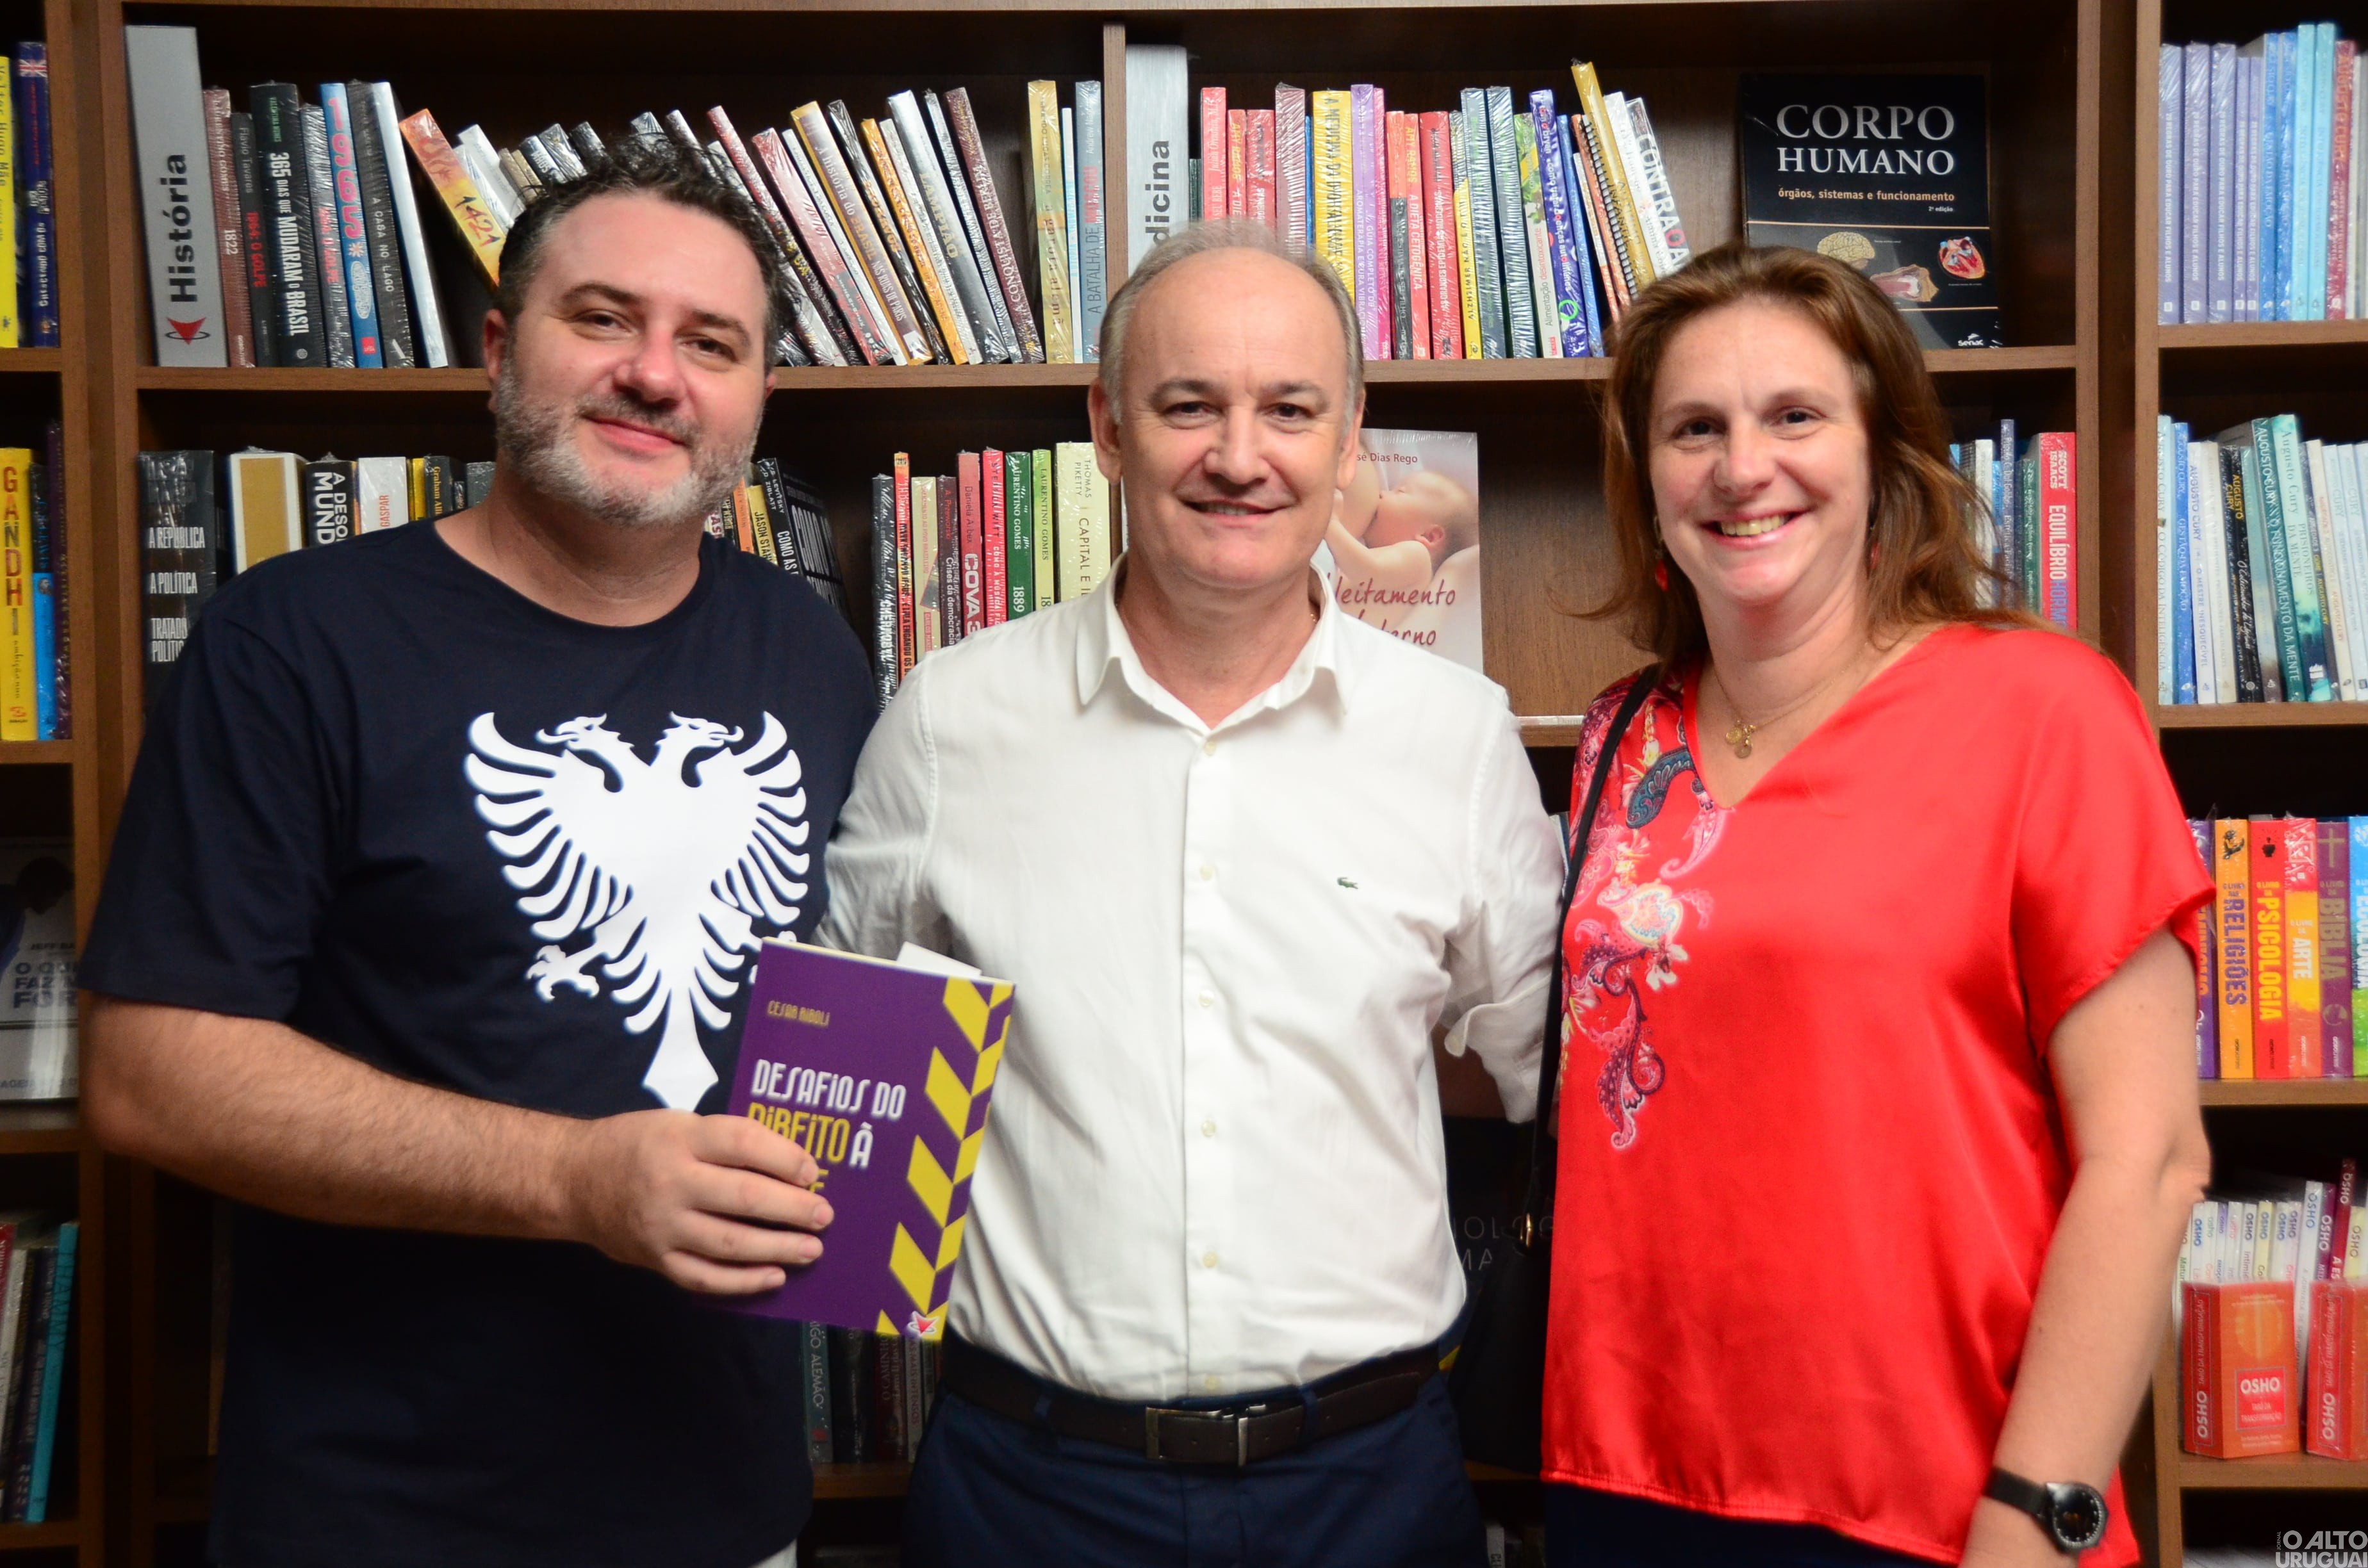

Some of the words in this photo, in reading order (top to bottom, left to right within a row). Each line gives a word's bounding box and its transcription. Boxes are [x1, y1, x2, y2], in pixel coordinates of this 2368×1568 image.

[1322, 108, 1342, 159] MEDICINA
[1776, 104, 1955, 140] CORPO
[269, 150, 292, 178] 365
[327, 98, 364, 238] 1965
[822, 154, 850, 200] história
[1776, 147, 1955, 176] HUMANO
[275, 178, 290, 197] DIAS
[1083, 165, 1100, 224] MOSCOU
[1145, 141, 1169, 247] dicina
[1778, 187, 1815, 200] órgãos,
[1818, 190, 1864, 200] sistemas
[1876, 190, 1955, 202] funcionamento
[279, 199, 292, 214] QUE
[374, 210, 386, 237] CASA
[454, 191, 499, 249] 1421
[843, 200, 857, 216] do
[920, 170, 958, 259] LAMPIÃO
[987, 211, 1000, 228] DE
[1354, 189, 1365, 253] AROMATERAPIA
[1409, 202, 1419, 229] DIETA
[161, 154, 197, 302] História
[223, 227, 239, 255] 1822
[1085, 226, 1100, 243] DE
[1365, 225, 1374, 245] GUIA
[277, 215, 304, 282] MUDARAM
[379, 243, 390, 257] NO
[1410, 231, 1424, 289] CETOGÊNICA
[1534, 227, 1548, 281] desintoxicante
[249, 251, 267, 287] GOLPE
[382, 265, 395, 292] LAGO
[869, 260, 885, 276] NAS
[876, 274, 893, 293] RUAS
[989, 230, 1024, 303] CONQUISTA
[1085, 246, 1103, 302] BATALHA
[1365, 248, 1376, 293] COMPLETO
[884, 291, 898, 303] DE
[1437, 269, 1447, 300] GRANDES
[1463, 266, 1476, 320] ALZHEIMER
[285, 290, 310, 336] BRASIL
[889, 300, 907, 322] PARIS
[1087, 304, 1103, 314] A
[1540, 281, 1554, 327] Alimentação
[1356, 453, 1367, 462] sé
[1370, 453, 1390, 462] Dias
[1393, 453, 1418, 464] Rego
[2256, 426, 2273, 477] AUGUSTO
[2279, 429, 2298, 480] Augusto
[332, 471, 345, 484] A
[431, 465, 444, 499] Graham
[1073, 461, 1083, 496] PIKETTY
[1083, 459, 1093, 498] THOMAS
[2048, 450, 2058, 489] ISAACS
[2056, 450, 2069, 489] SCOTT
[764, 480, 777, 511] ZIBLATT
[772, 478, 784, 514] LEVITSKY
[963, 485, 974, 516] Daniela
[1039, 467, 1049, 526] LAURENTINO
[2157, 482, 2166, 512] CURY
[2188, 464, 2200, 512] AUGUSTO
[2224, 483, 2235, 510] CURY
[2231, 473, 2244, 520] AUGUSTO
[2285, 483, 2301, 514] Cury
[330, 491, 352, 540] DESO
[375, 494, 393, 528] GASPAR
[753, 510, 768, 537] JASON
[991, 512, 1000, 539] WITT
[2191, 514, 2201, 541] CURY
[149, 527, 155, 548] A
[776, 529, 795, 557] COMO
[1012, 518, 1022, 551] GOMES
[1040, 528, 1049, 561] GOMES
[1077, 516, 1092, 570] CAPITAL
[2048, 504, 2071, 580] EQUILÍBRIO
[2176, 516, 2189, 552] GESTÃO
[2286, 523, 2297, 539] DA
[3, 466, 22, 635] GANDHI
[782, 556, 798, 571] AS
[992, 545, 1000, 568] COMO
[2157, 544, 2168, 585] CÓDIGO
[2289, 541, 2303, 578] MENTE
[2296, 521, 2315, 596] PRISIONEIROS
[150, 573, 157, 594] A
[158, 570, 198, 594] POLÍTICA
[943, 556, 955, 584] Crises
[962, 551, 982, 619] COVA
[2269, 528, 2292, 625] FUNCIONAMENTO
[944, 585, 953, 596] da
[1011, 584, 1026, 613] 1889
[1040, 594, 1051, 608] 18
[1328, 574, 1456, 605] leitamento
[2157, 588, 2166, 600] DA
[2195, 576, 2205, 607] MESTRE
[2235, 568, 2253, 610] Colecionador
[151, 617, 188, 639] TRATADO
[877, 599, 896, 662] CHERNOBYL
[944, 596, 958, 646] democracia
[2157, 603, 2168, 670] INTELIGÊNCIA
[2196, 608, 2210, 667] INESQUECÍVEL
[2282, 626, 2294, 643] DA
[2284, 644, 2300, 683] MENTE
[2224, 899, 2249, 1006] RELIGIÕES
[2319, 898, 2346, 981] BÍBLIA
[2257, 897, 2282, 1020] PSICOLOGIA
[2292, 937, 2313, 980] ARTE
[751, 1058, 871, 1113] DESAFIOS
[871, 1081, 907, 1120] DO
[2340, 1172, 2354, 1204] OSHO
[2245, 1212, 2255, 1241] OSHO
[2260, 1211, 2269, 1240] OSHO
[2277, 1212, 2287, 1241] OSHO
[2288, 1210, 2298, 1239] OSHO
[2306, 1193, 2318, 1229] OSHO
[2194, 1218, 2203, 1247] OSHO
[2319, 1214, 2332, 1252] OSHO
[2349, 1225, 2362, 1258] OSHO
[809, 1352, 826, 1405] ALEMÃO
[2240, 1376, 2281, 1394] OSHO
[2196, 1390, 2208, 1439] OSHO
[2322, 1392, 2336, 1440] OSHO
